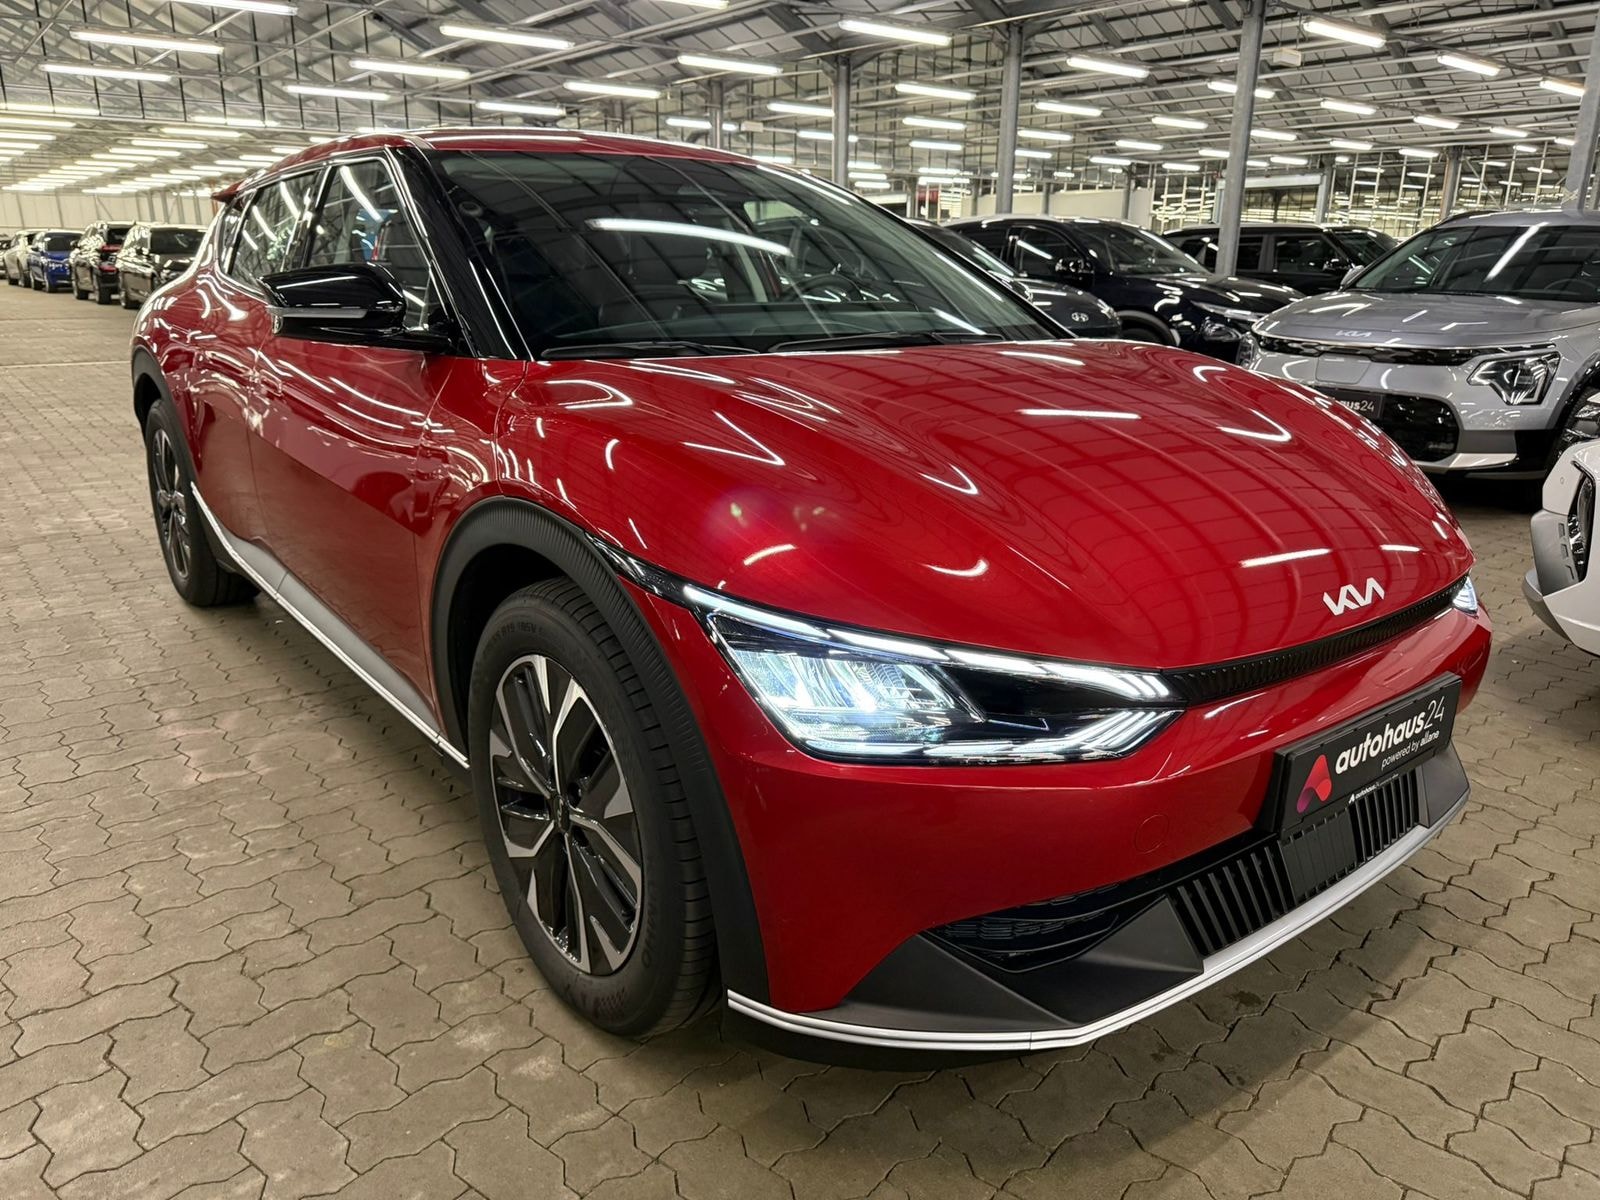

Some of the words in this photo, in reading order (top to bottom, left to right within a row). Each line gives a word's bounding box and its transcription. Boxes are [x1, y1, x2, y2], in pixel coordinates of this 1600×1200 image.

[1335, 696, 1445, 775] autohaus24
[1381, 741, 1411, 771] powered
[1411, 740, 1420, 753] by
